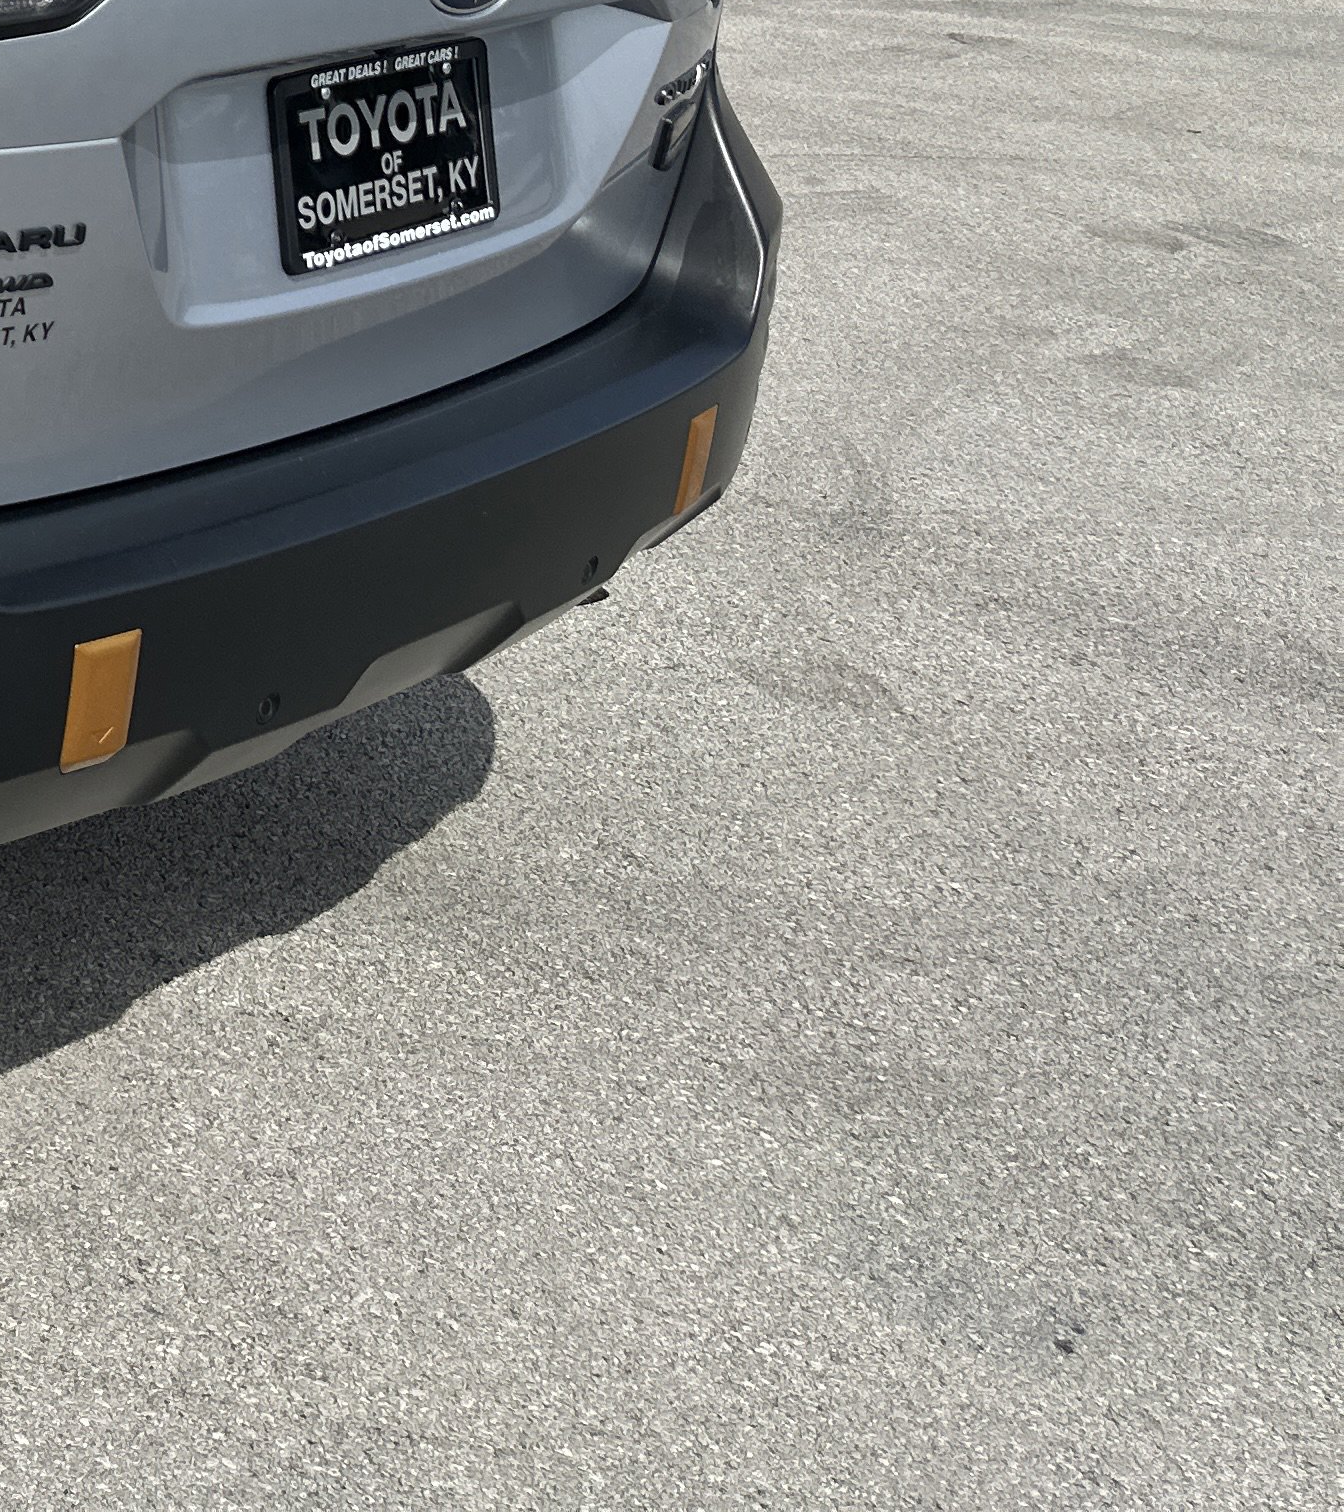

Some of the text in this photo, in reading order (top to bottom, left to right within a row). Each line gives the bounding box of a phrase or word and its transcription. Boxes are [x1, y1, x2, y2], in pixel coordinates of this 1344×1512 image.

[310, 68, 347, 89] GREAT
[394, 53, 427, 71] GREAT
[298, 79, 467, 161] TOYOTA
[380, 149, 404, 175] OF
[297, 155, 480, 230] SOMERSET, KY
[301, 205, 496, 269] ToyotaofSomerset.com
[22, 320, 56, 344] KY
